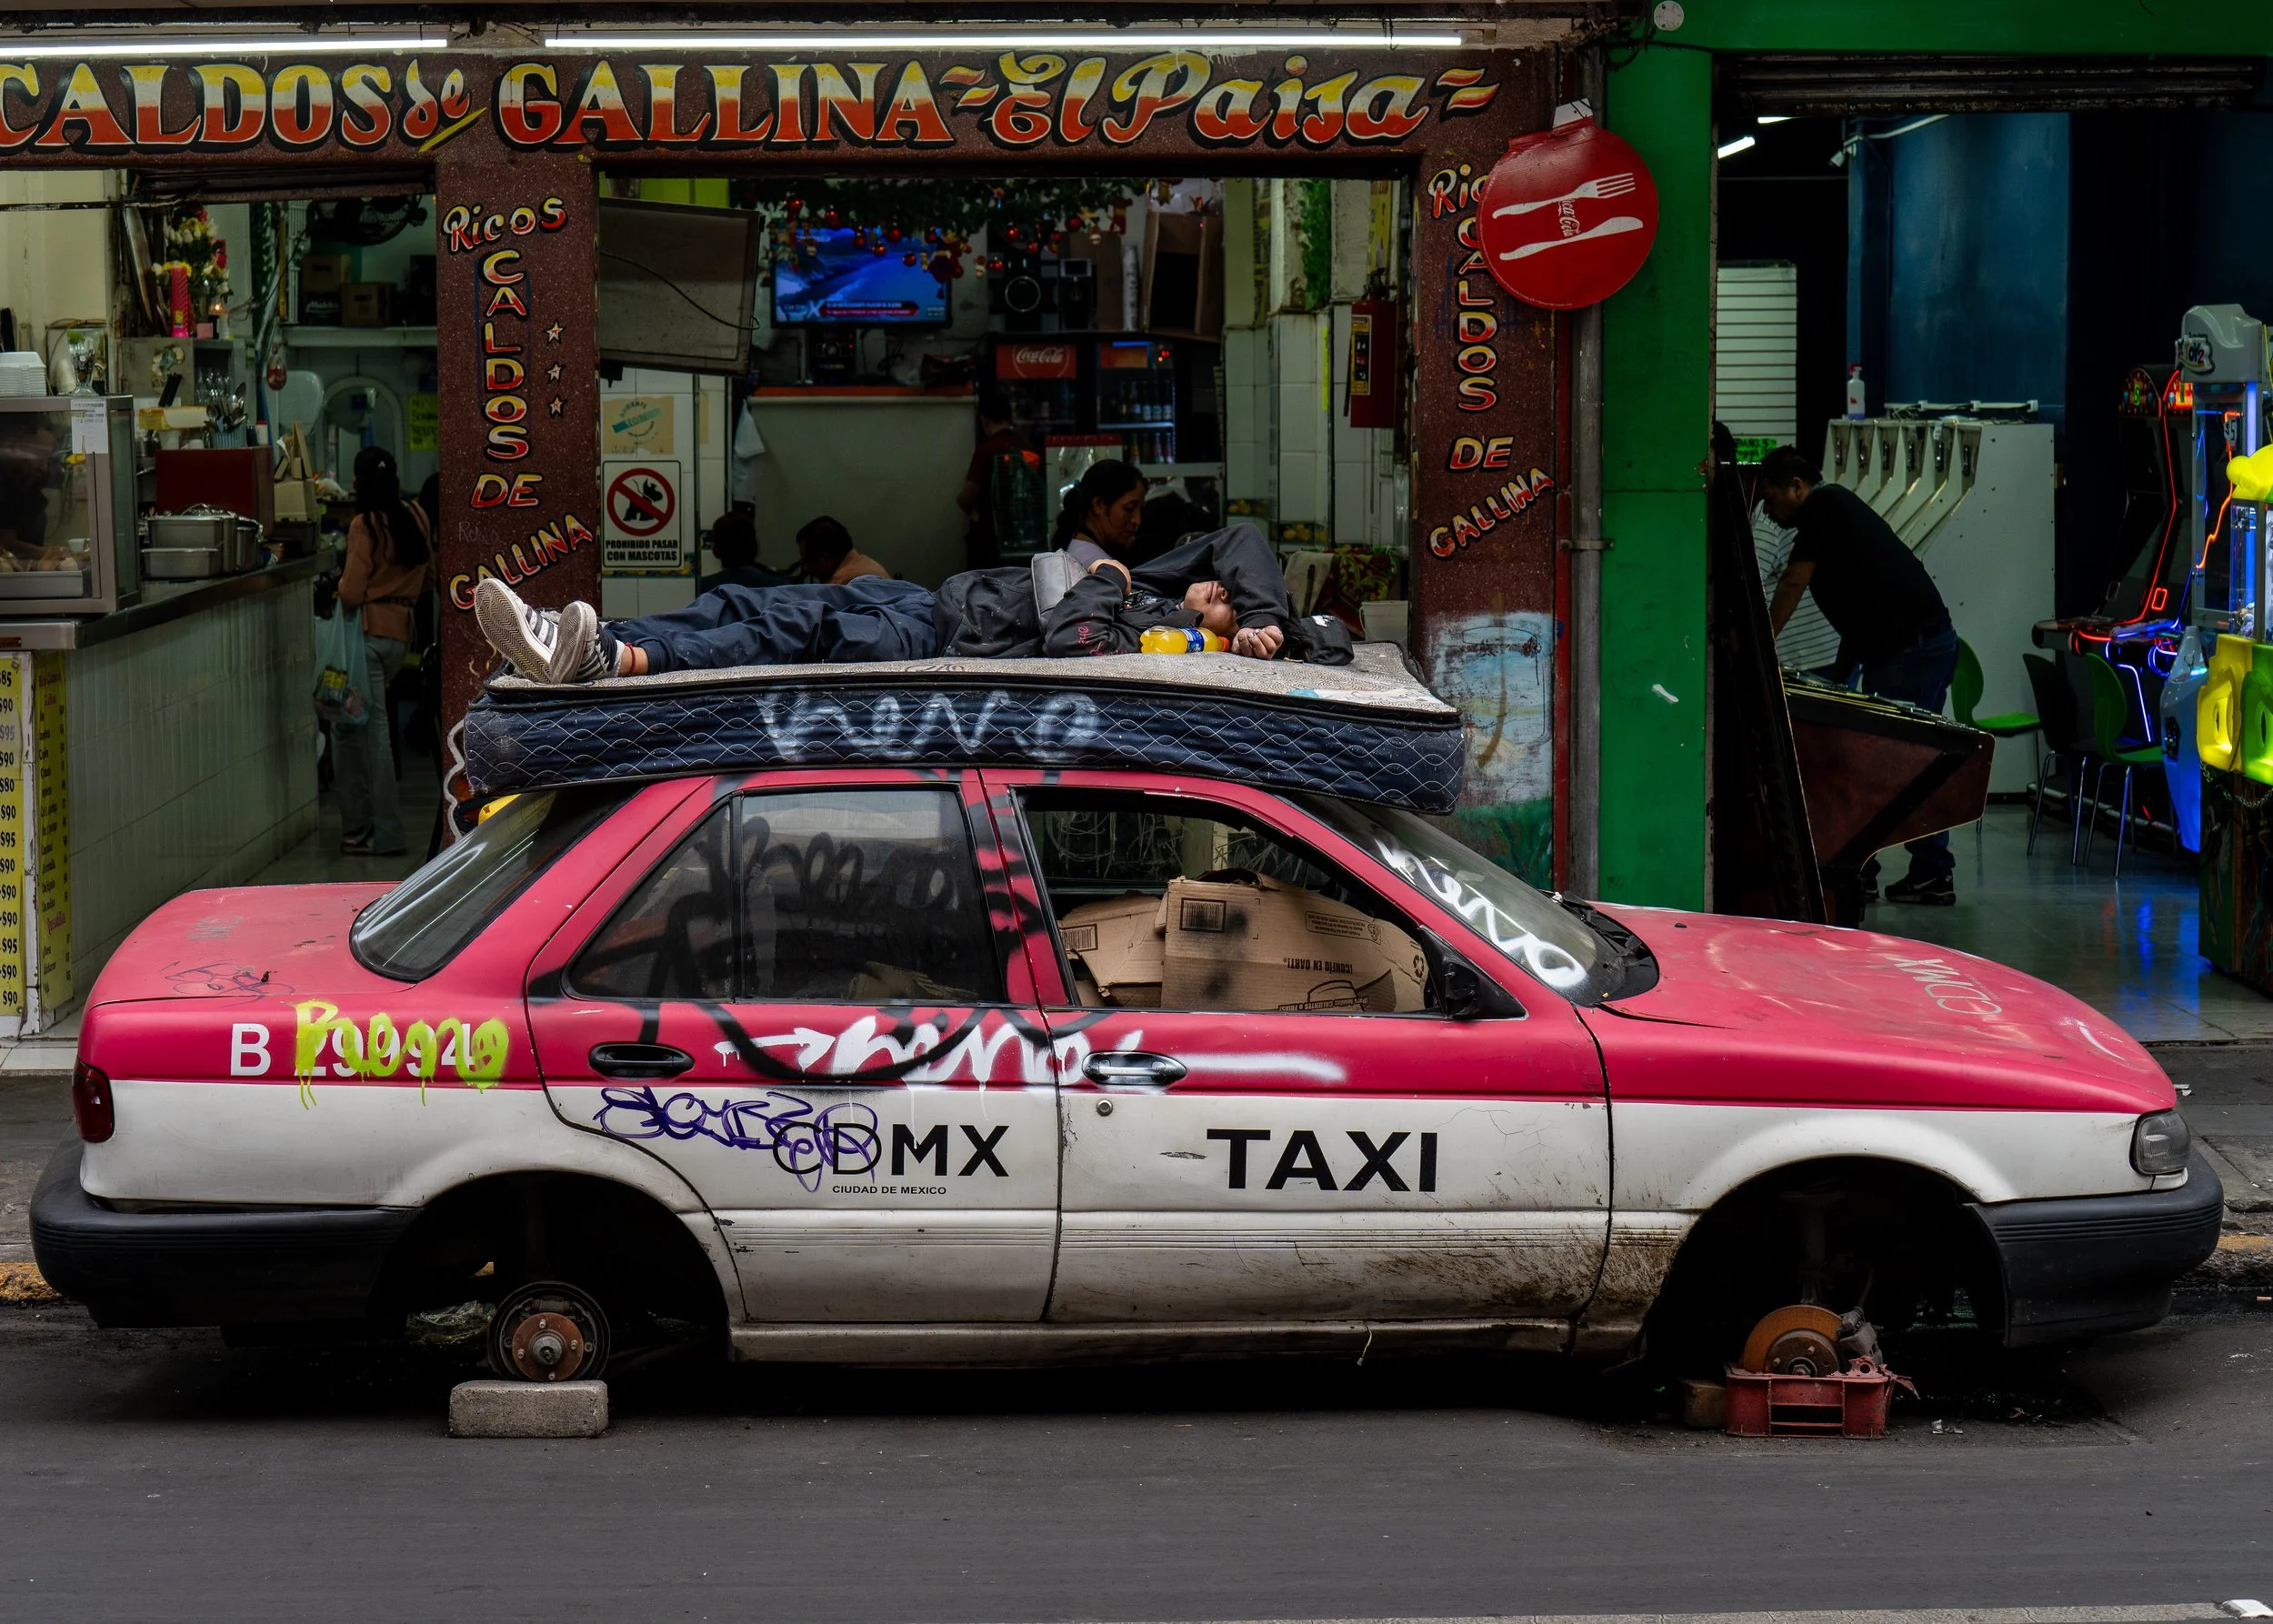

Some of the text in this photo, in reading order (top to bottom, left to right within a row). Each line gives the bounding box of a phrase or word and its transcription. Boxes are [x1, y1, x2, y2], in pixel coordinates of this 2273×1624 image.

[0, 50, 1431, 147] CALDOS de GALLINA El Paisa
[1428, 164, 1486, 220] Ric
[443, 195, 566, 253] Ricos
[483, 249, 529, 460] CALDOS
[1449, 436, 1515, 469] DE
[471, 473, 543, 507] DE
[1429, 466, 1555, 557] GALLINA
[605, 540, 678, 549] PROHIBIDO PASAR
[606, 552, 677, 561] CON MASCOTAS
[0, 670, 12, 687] 85
[1, 804, 16, 821] $90
[0, 830, 15, 847] $95
[0, 857, 15, 874] $90
[1312, 959, 1323, 972] EN
[2, 989, 18, 1006] $90
[230, 1023, 272, 1077] B
[772, 1122, 1010, 1178] CDMX
[1206, 1128, 1438, 1193] TAXI
[832, 1185, 947, 1196] CIUDAD DE MEXICO
